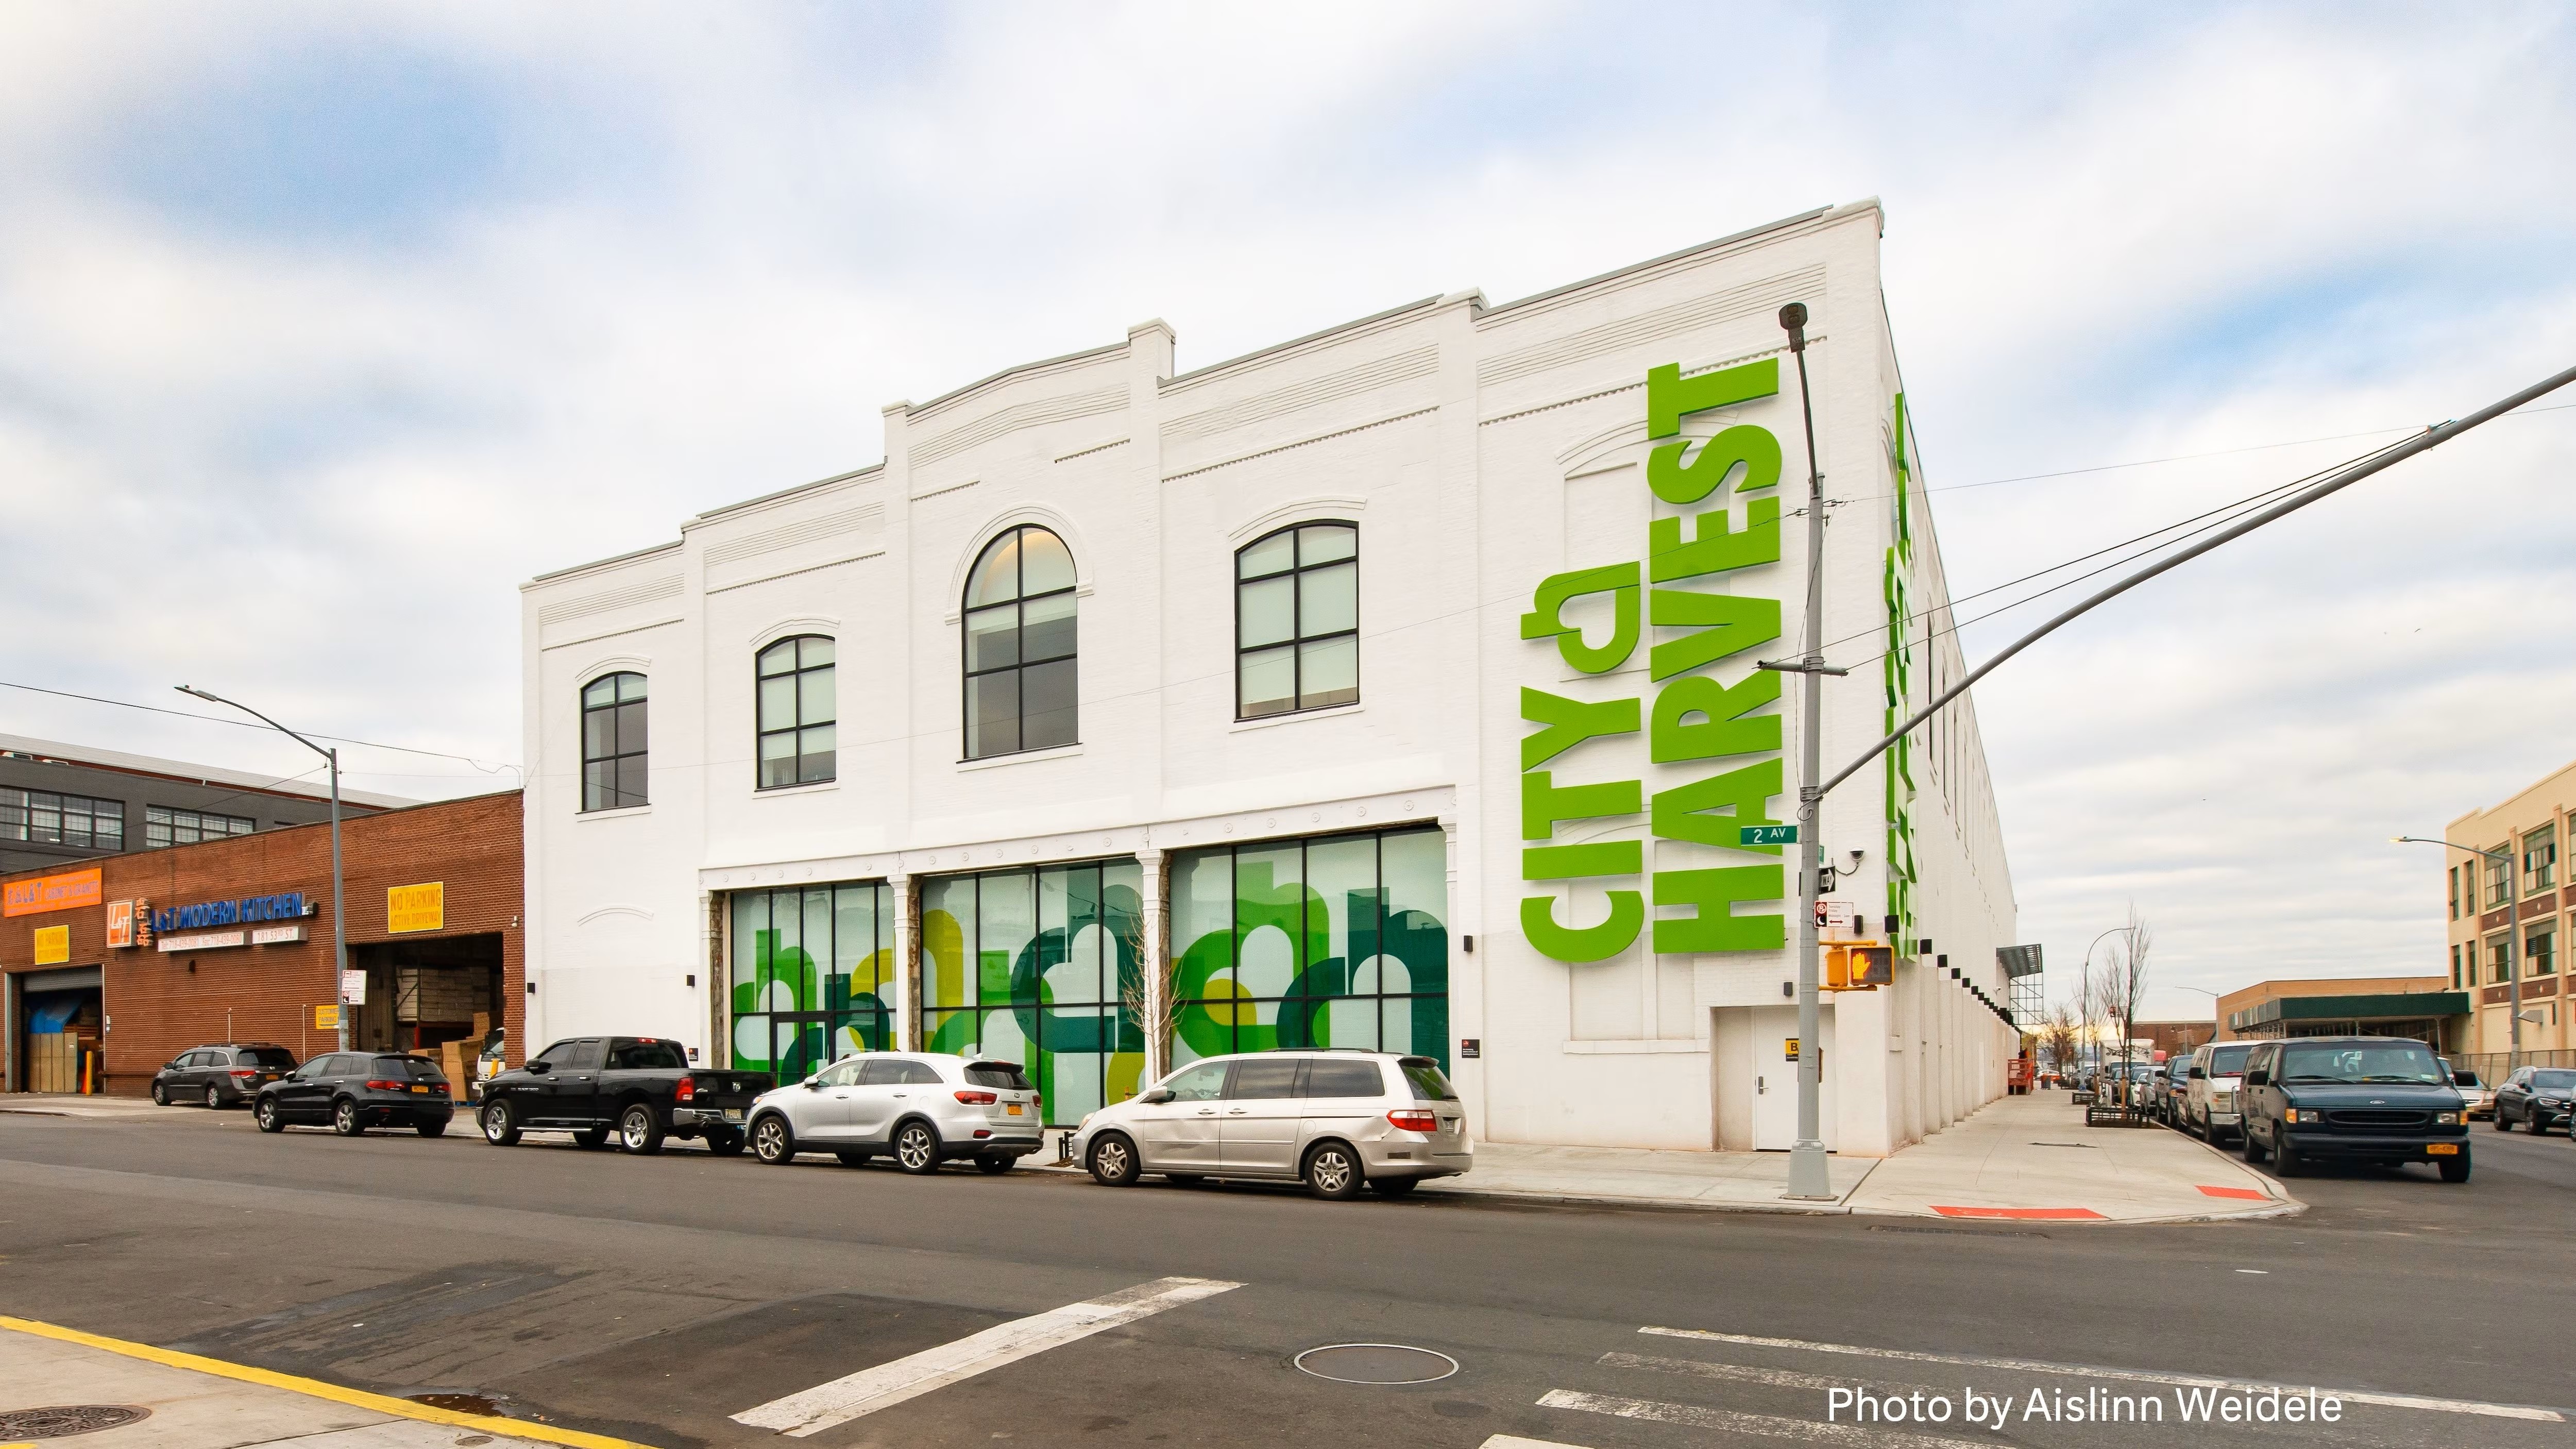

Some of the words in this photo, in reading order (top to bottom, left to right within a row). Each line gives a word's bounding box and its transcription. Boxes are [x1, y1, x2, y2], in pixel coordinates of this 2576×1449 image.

[1648, 357, 1785, 954] HARVEST
[1520, 686, 1645, 963] CITY
[1753, 829, 1762, 843] 2
[1770, 828, 1786, 838] AV
[1822, 874, 1832, 886] WAY
[180, 899, 237, 929] MODERN
[242, 891, 303, 923] KITCHEN
[391, 892, 402, 912] NO
[405, 888, 442, 910] PARKING
[391, 913, 411, 927] ACTIVE
[412, 911, 442, 924] DRIVEWAY
[258, 931, 267, 942] 181
